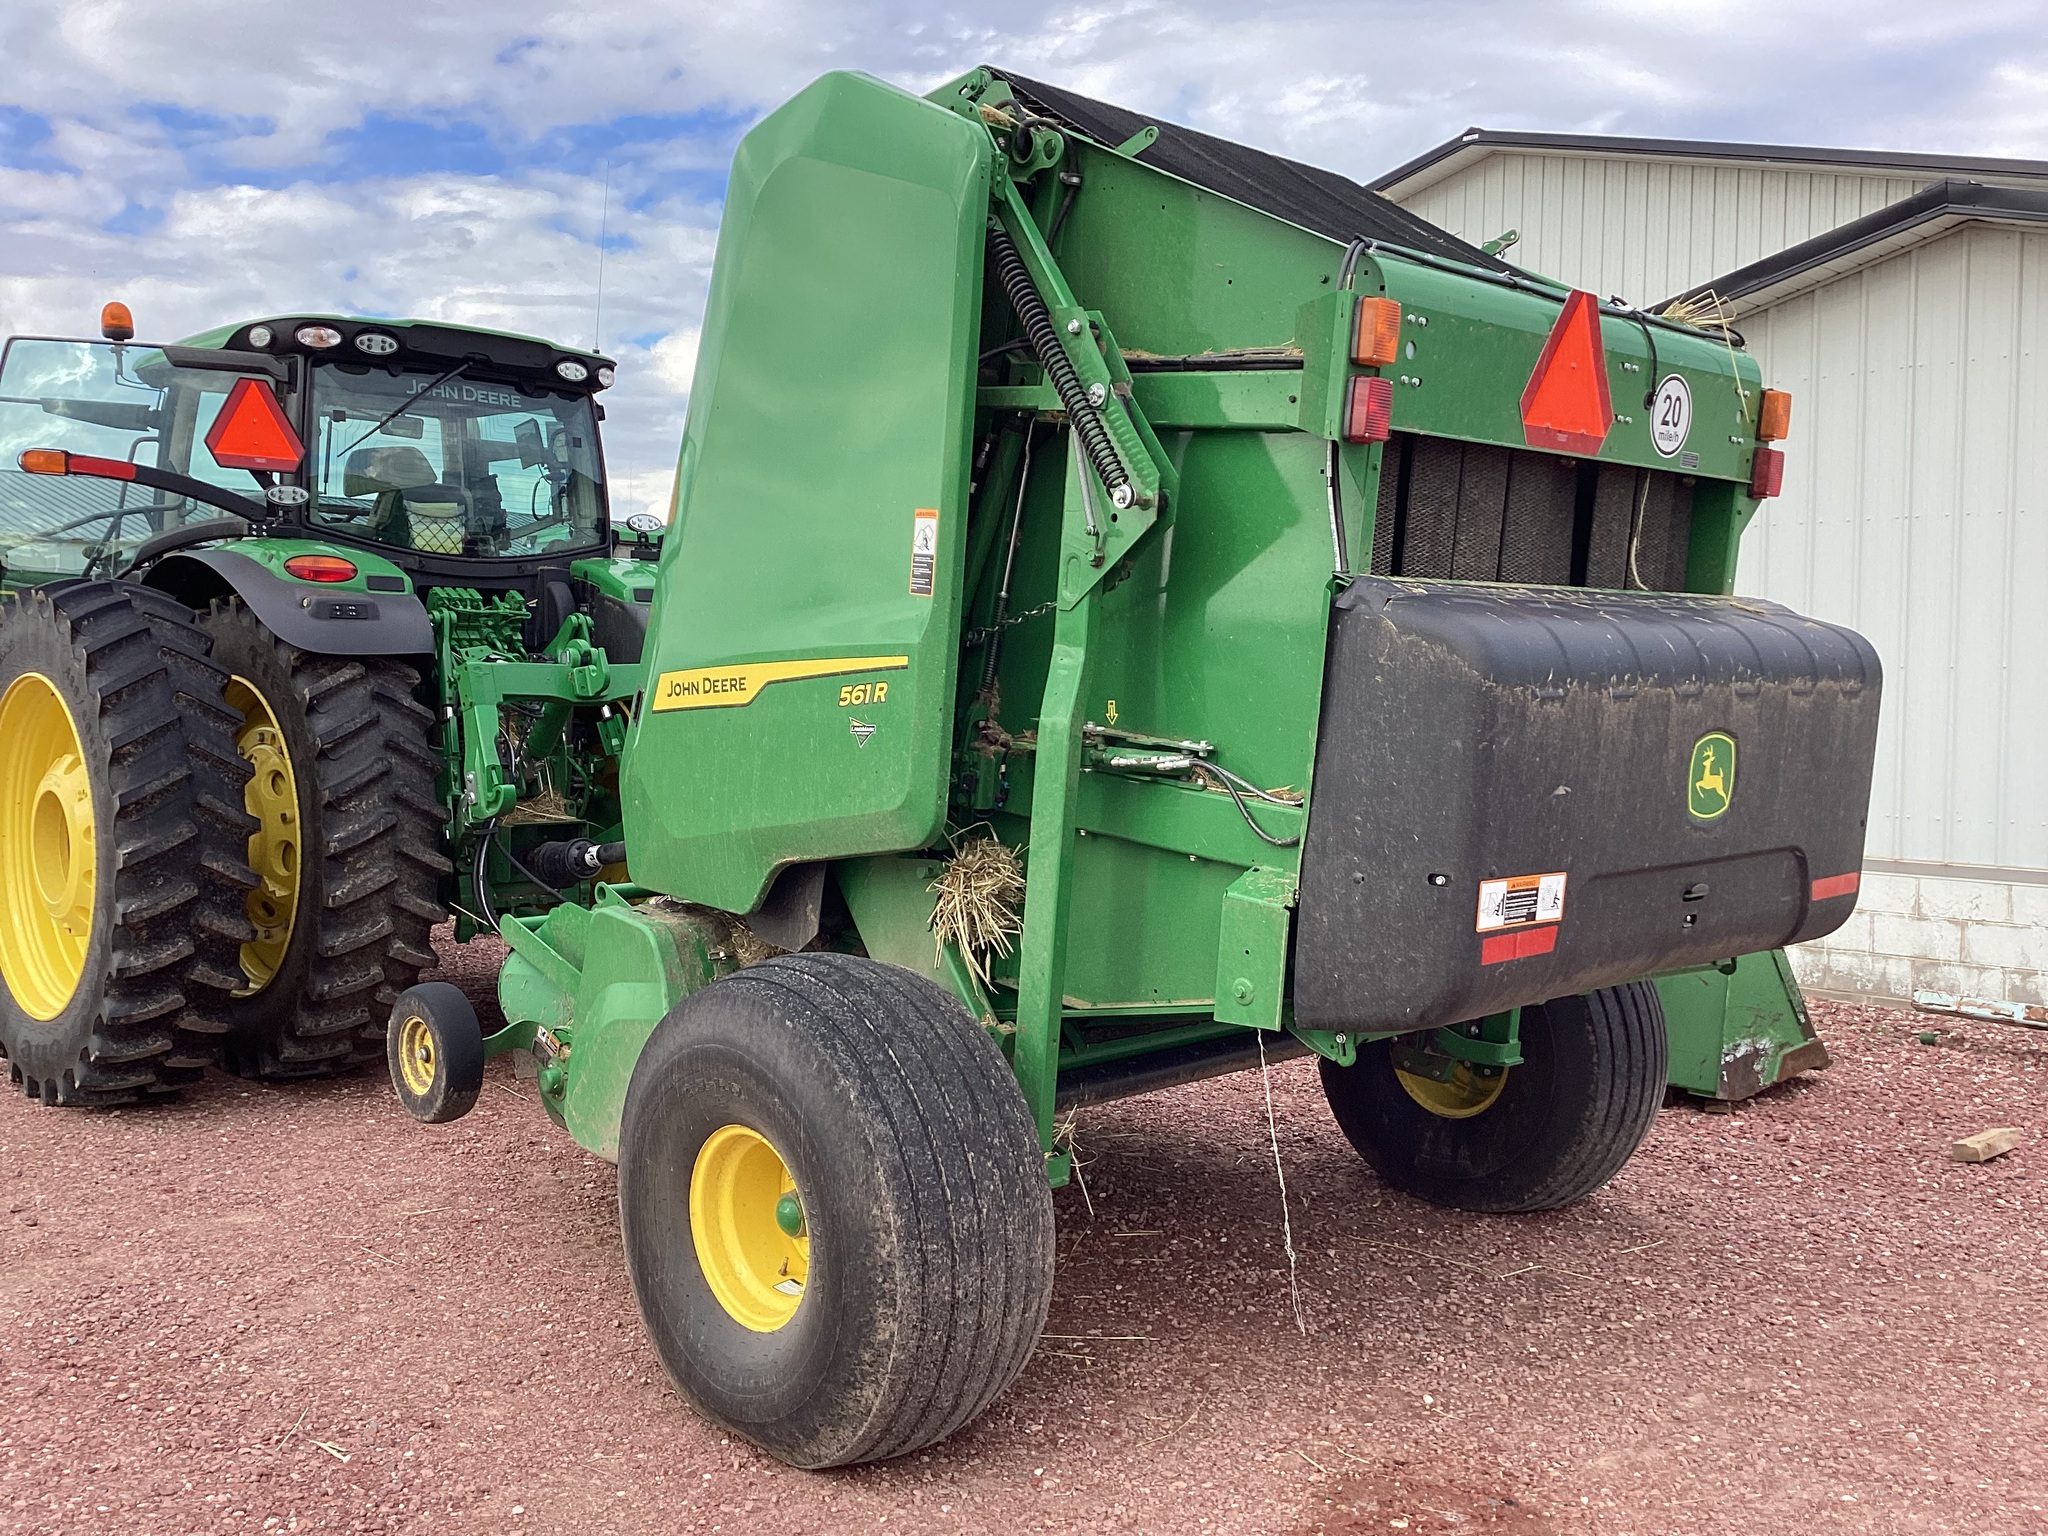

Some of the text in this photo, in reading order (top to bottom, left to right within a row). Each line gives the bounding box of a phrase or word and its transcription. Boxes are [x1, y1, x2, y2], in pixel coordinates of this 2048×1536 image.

[406, 379, 522, 408] JOHN DEERE
[1661, 393, 1682, 428] 20
[1658, 430, 1680, 443] mile/h
[667, 676, 747, 698] JOHN DEERE
[838, 681, 888, 707] 561R
